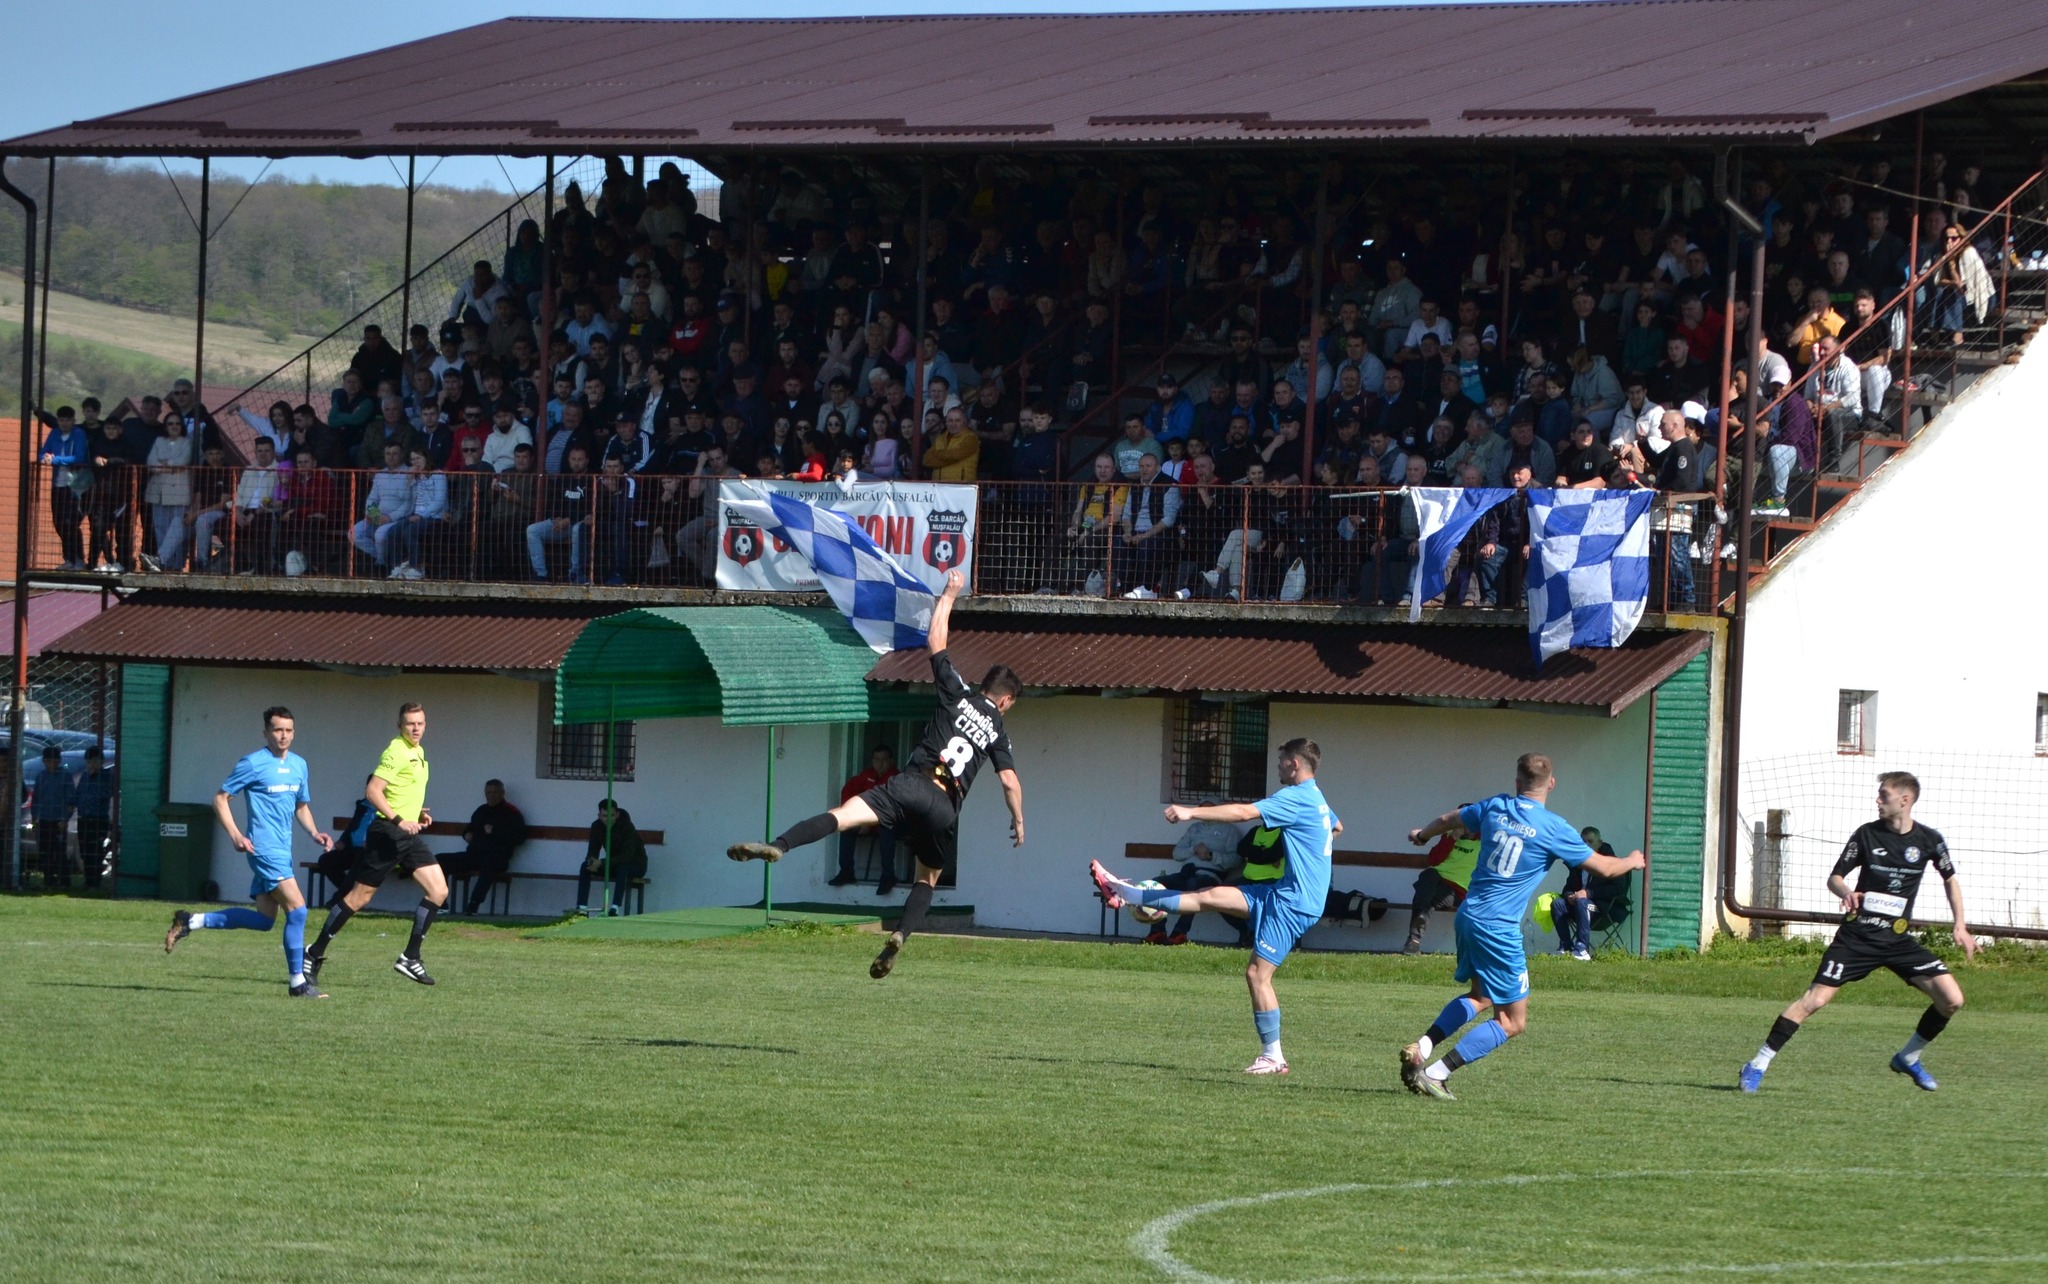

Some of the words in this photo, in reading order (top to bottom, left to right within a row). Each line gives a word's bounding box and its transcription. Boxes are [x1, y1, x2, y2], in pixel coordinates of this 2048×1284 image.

[799, 491, 839, 501] SPORTIV
[940, 736, 974, 777] 8
[1487, 829, 1524, 879] 20
[1518, 969, 1530, 994] 2
[1822, 960, 1844, 980] 11
